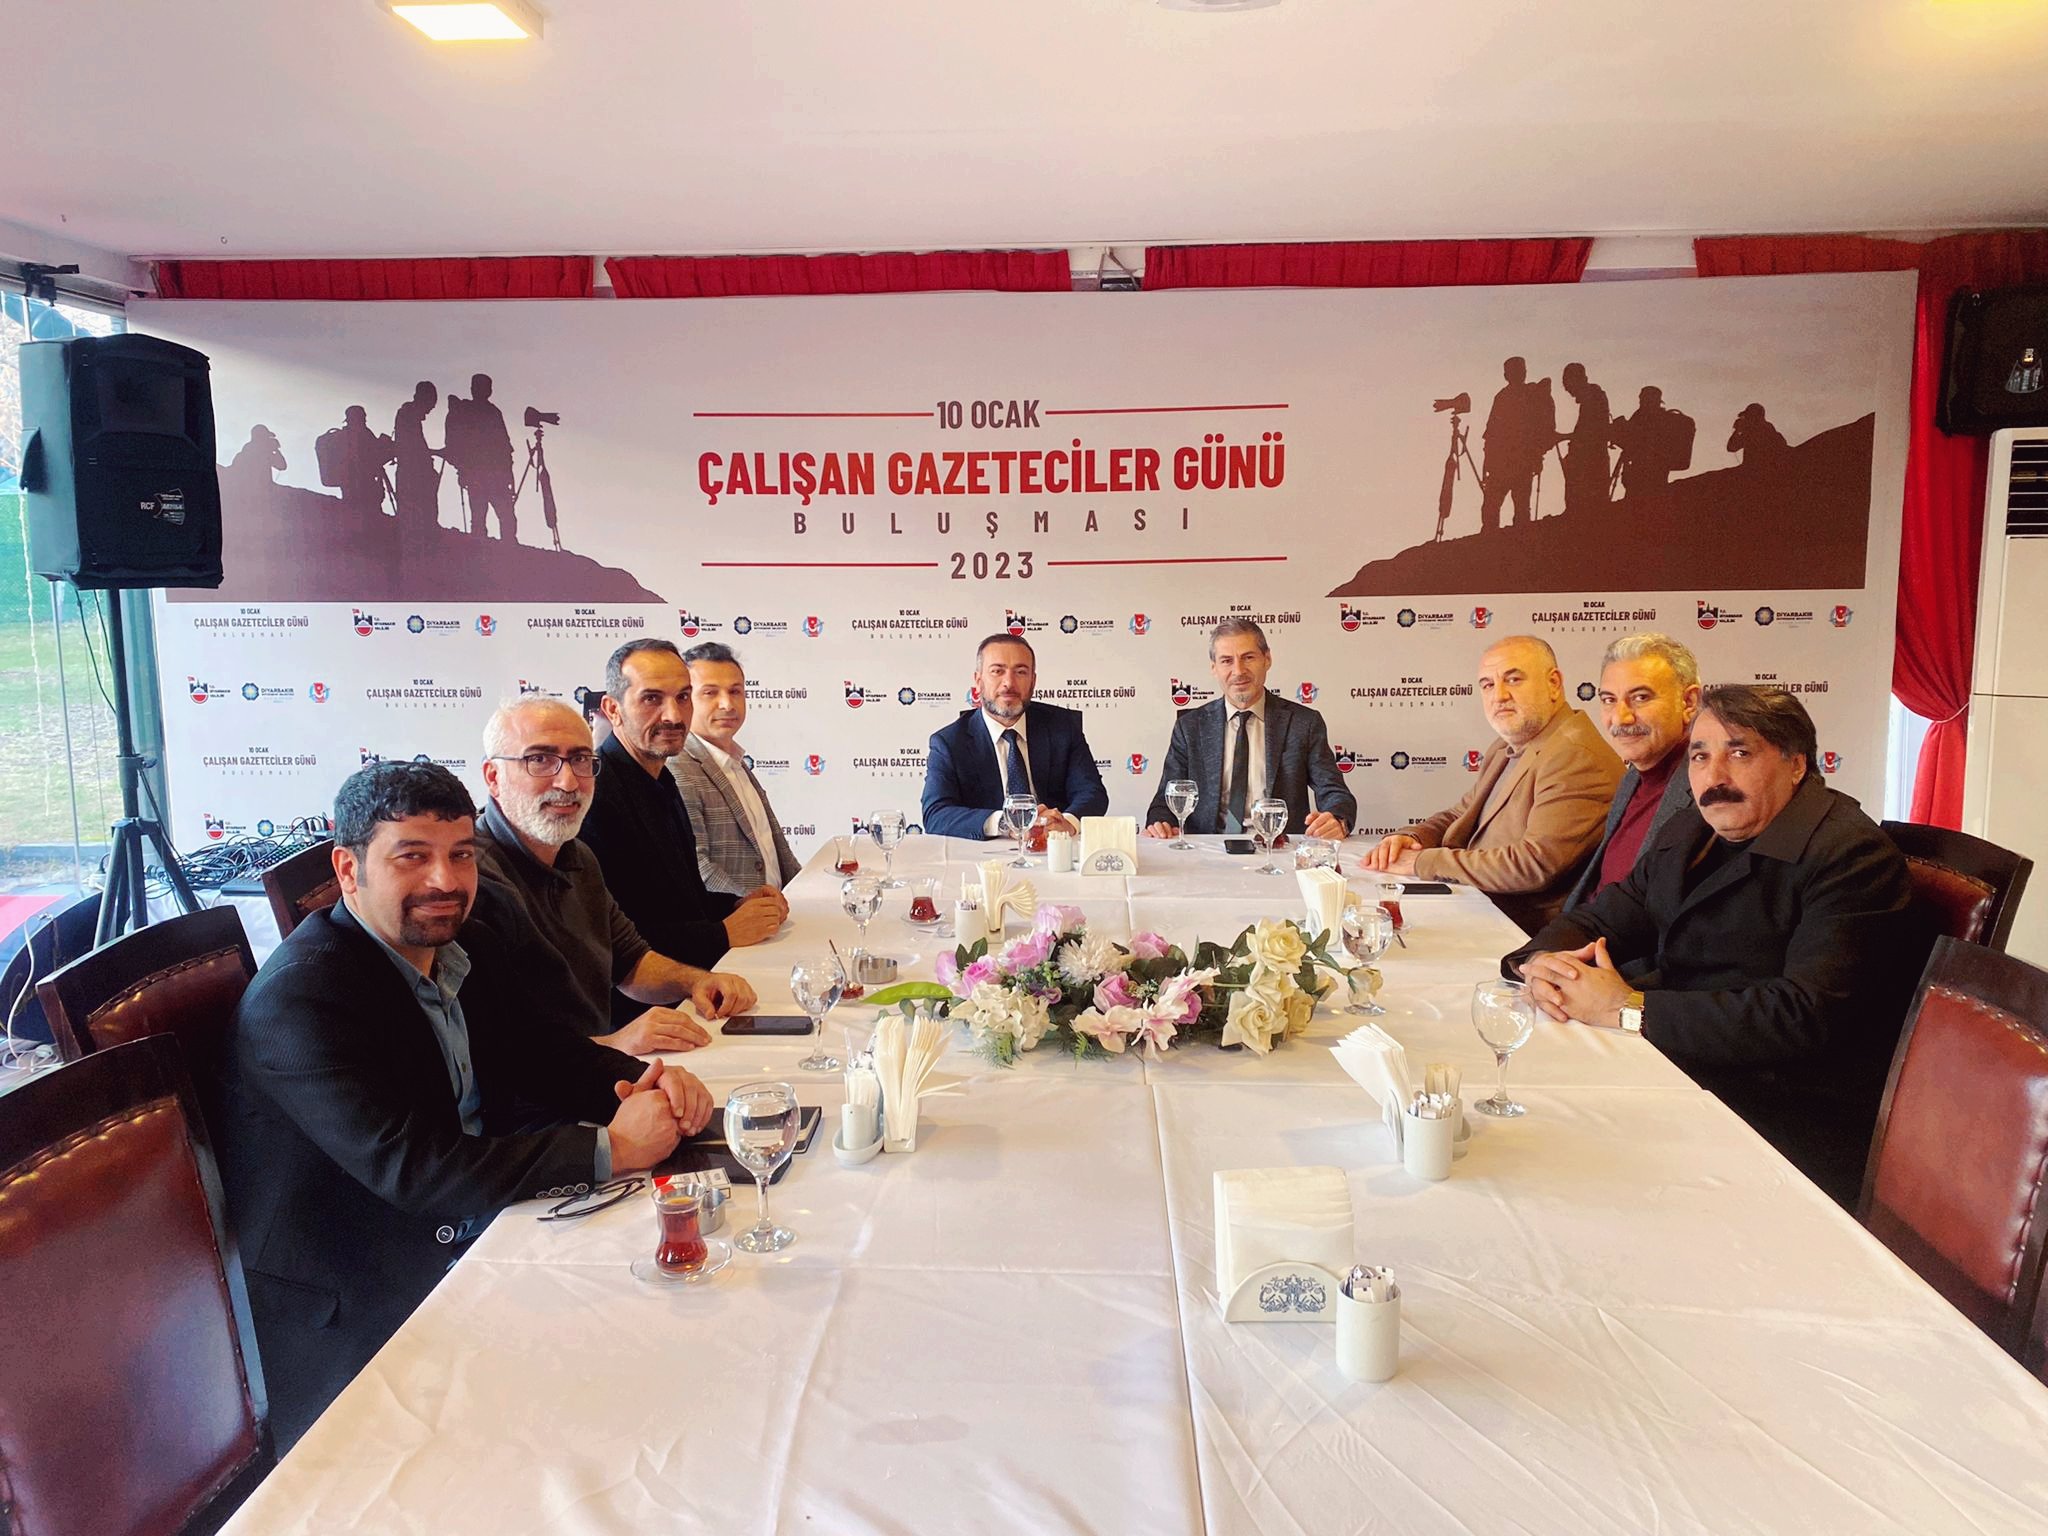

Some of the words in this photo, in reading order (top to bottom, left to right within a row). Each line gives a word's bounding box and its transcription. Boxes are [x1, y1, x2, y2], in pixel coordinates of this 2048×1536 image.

[937, 401, 961, 429] 10
[971, 400, 1040, 428] OCAK
[698, 451, 874, 506] ÇALIŞAN
[888, 438, 1160, 495] GAZETECİLER
[1174, 431, 1285, 490] GÜNÜ
[140, 502, 155, 510] RCF
[794, 508, 1188, 539] BULUŞMASI
[951, 551, 1034, 580] 2023
[194, 618, 229, 629] ÇALIŞAN
[231, 616, 285, 627] GAZETECİLER
[287, 616, 309, 627] GÜNÜ
[1181, 616, 1217, 627] ÇALIŞAN
[1278, 612, 1301, 623] GÜNÜ
[1532, 612, 1570, 624] ÇALIŞAN
[1572, 610, 1630, 621] GAZETECİLER
[1632, 609, 1656, 620] GÜNÜ
[527, 618, 563, 630] ÇALIŞAN
[565, 617, 620, 628] GAZETECİLER
[622, 617, 644, 628] GÜNÜ
[852, 619, 887, 630] ÇALIŞAN
[890, 618, 944, 628] GAZETECİLER
[946, 617, 968, 628] GÜNÜ
[1057, 687, 1111, 698] GAZETECİLER
[1113, 687, 1135, 698] GÜNÜ
[1351, 688, 1388, 699] ÇALIŞAN
[1390, 685, 1447, 697] GAZETECİLER
[1450, 684, 1473, 696] GÜNÜ
[1804, 681, 1828, 692] GÜNÜ
[366, 689, 402, 700] ÇALIŞAN
[404, 687, 458, 698] GAZETECİLER
[460, 687, 482, 698] GÜNÜ
[785, 688, 807, 699] GÜNÜ
[203, 756, 238, 767] ÇALIŞAN
[240, 755, 293, 765] GAZETECİLER
[294, 755, 316, 765] GÜNÜ
[853, 758, 888, 769] ÇALIŞAN
[794, 825, 815, 835] GÜNÜ
